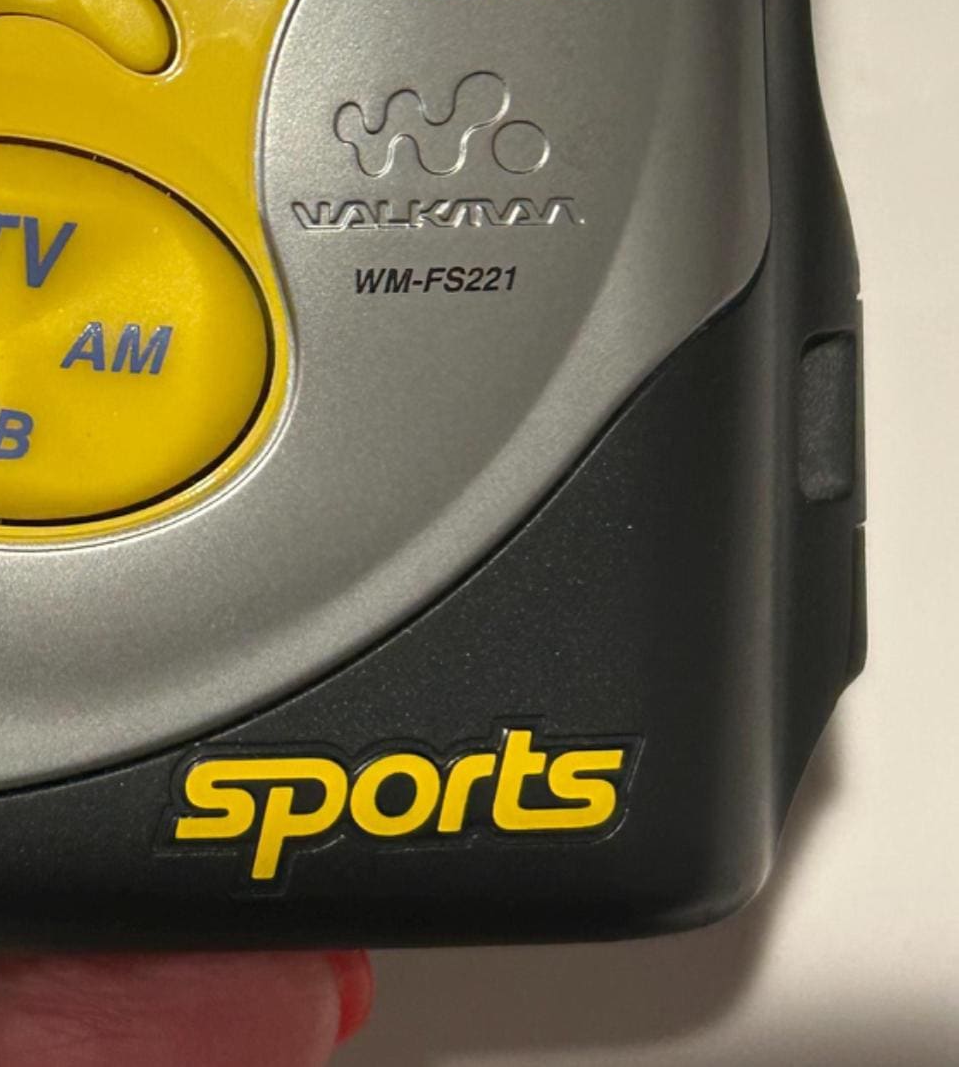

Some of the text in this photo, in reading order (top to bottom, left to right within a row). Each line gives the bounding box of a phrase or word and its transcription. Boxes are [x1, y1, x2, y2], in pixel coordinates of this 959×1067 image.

[291, 197, 583, 232] WALKMAN
[354, 266, 517, 294] WM-FS221
[59, 320, 173, 375] AM
[175, 730, 623, 879] sports
